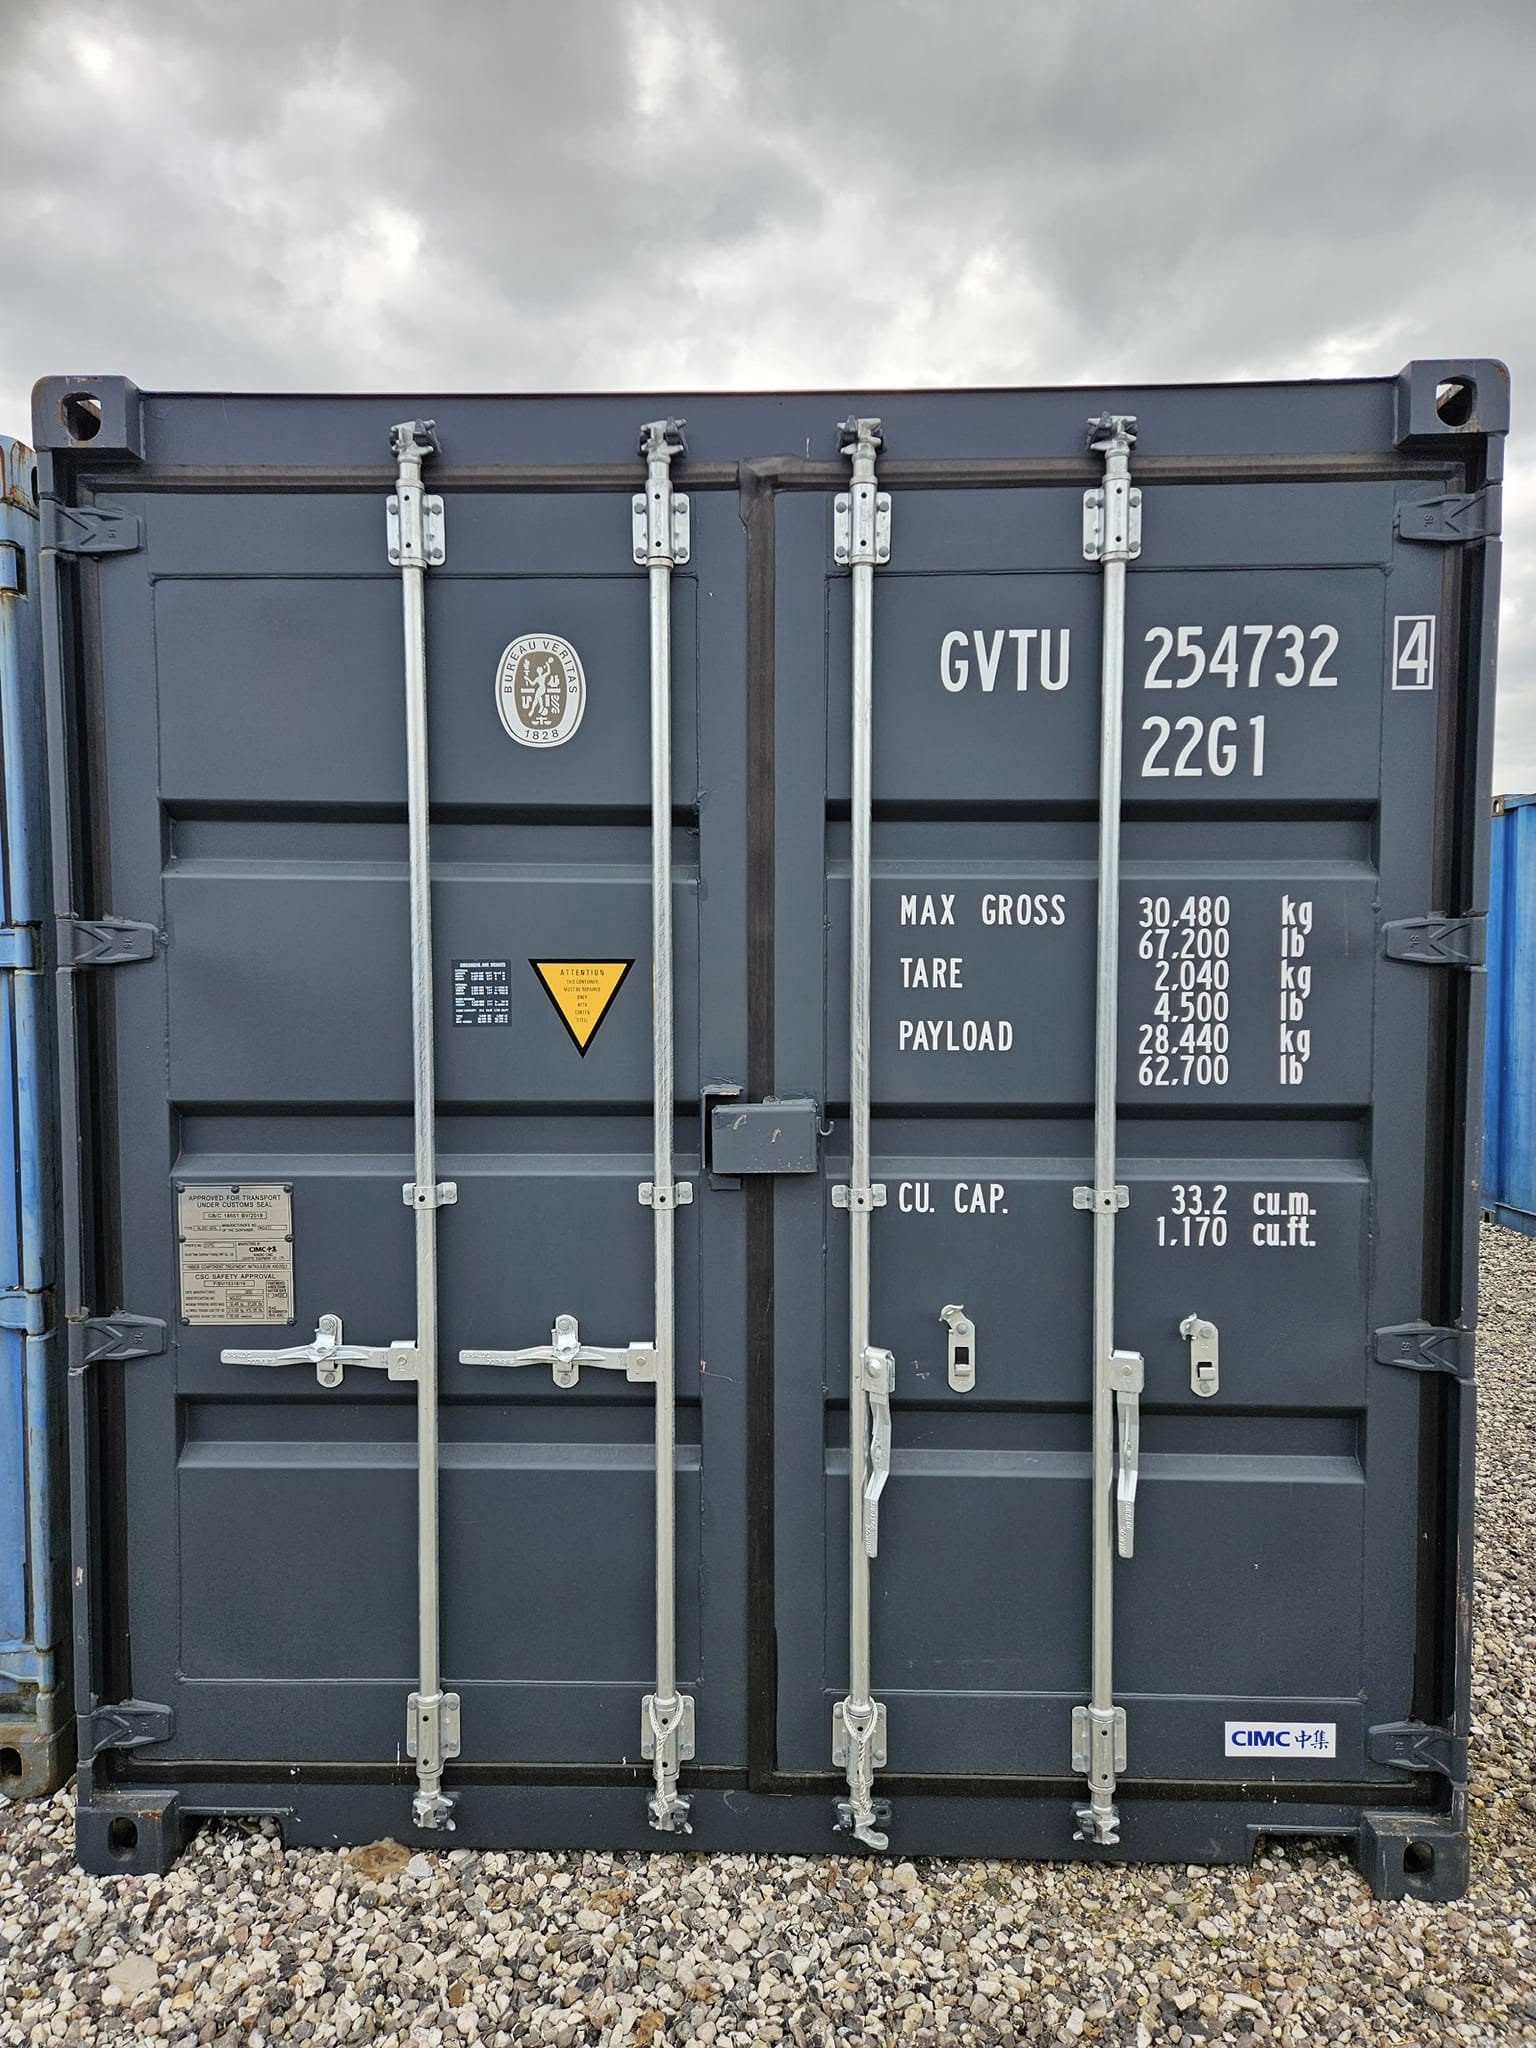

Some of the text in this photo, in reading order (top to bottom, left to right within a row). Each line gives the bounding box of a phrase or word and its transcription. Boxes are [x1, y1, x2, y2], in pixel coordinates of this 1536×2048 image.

[504, 641, 578, 694] BUREAU VERITAS
[941, 623, 1428, 692] GVTU 254732 4
[525, 729, 560, 740] 1828
[1142, 715, 1265, 777] 22G1
[901, 894, 1313, 934] MAX GROSS 30,480 kg
[1139, 927, 1305, 959] 67,200 lb
[901, 958, 1312, 999] TARE 2,040 kg
[1154, 991, 1304, 1022] 4,500 lb
[900, 1021, 1311, 1062] PAYLOAD 28,440 kg
[1138, 1054, 1303, 1085] 62,700 lb
[899, 1183, 1317, 1216] CU. CAP. 33.2 cu.m.
[1156, 1216, 1316, 1247] 1,170 cu.ft.
[1231, 1730, 1329, 1750] CIMC 中集
